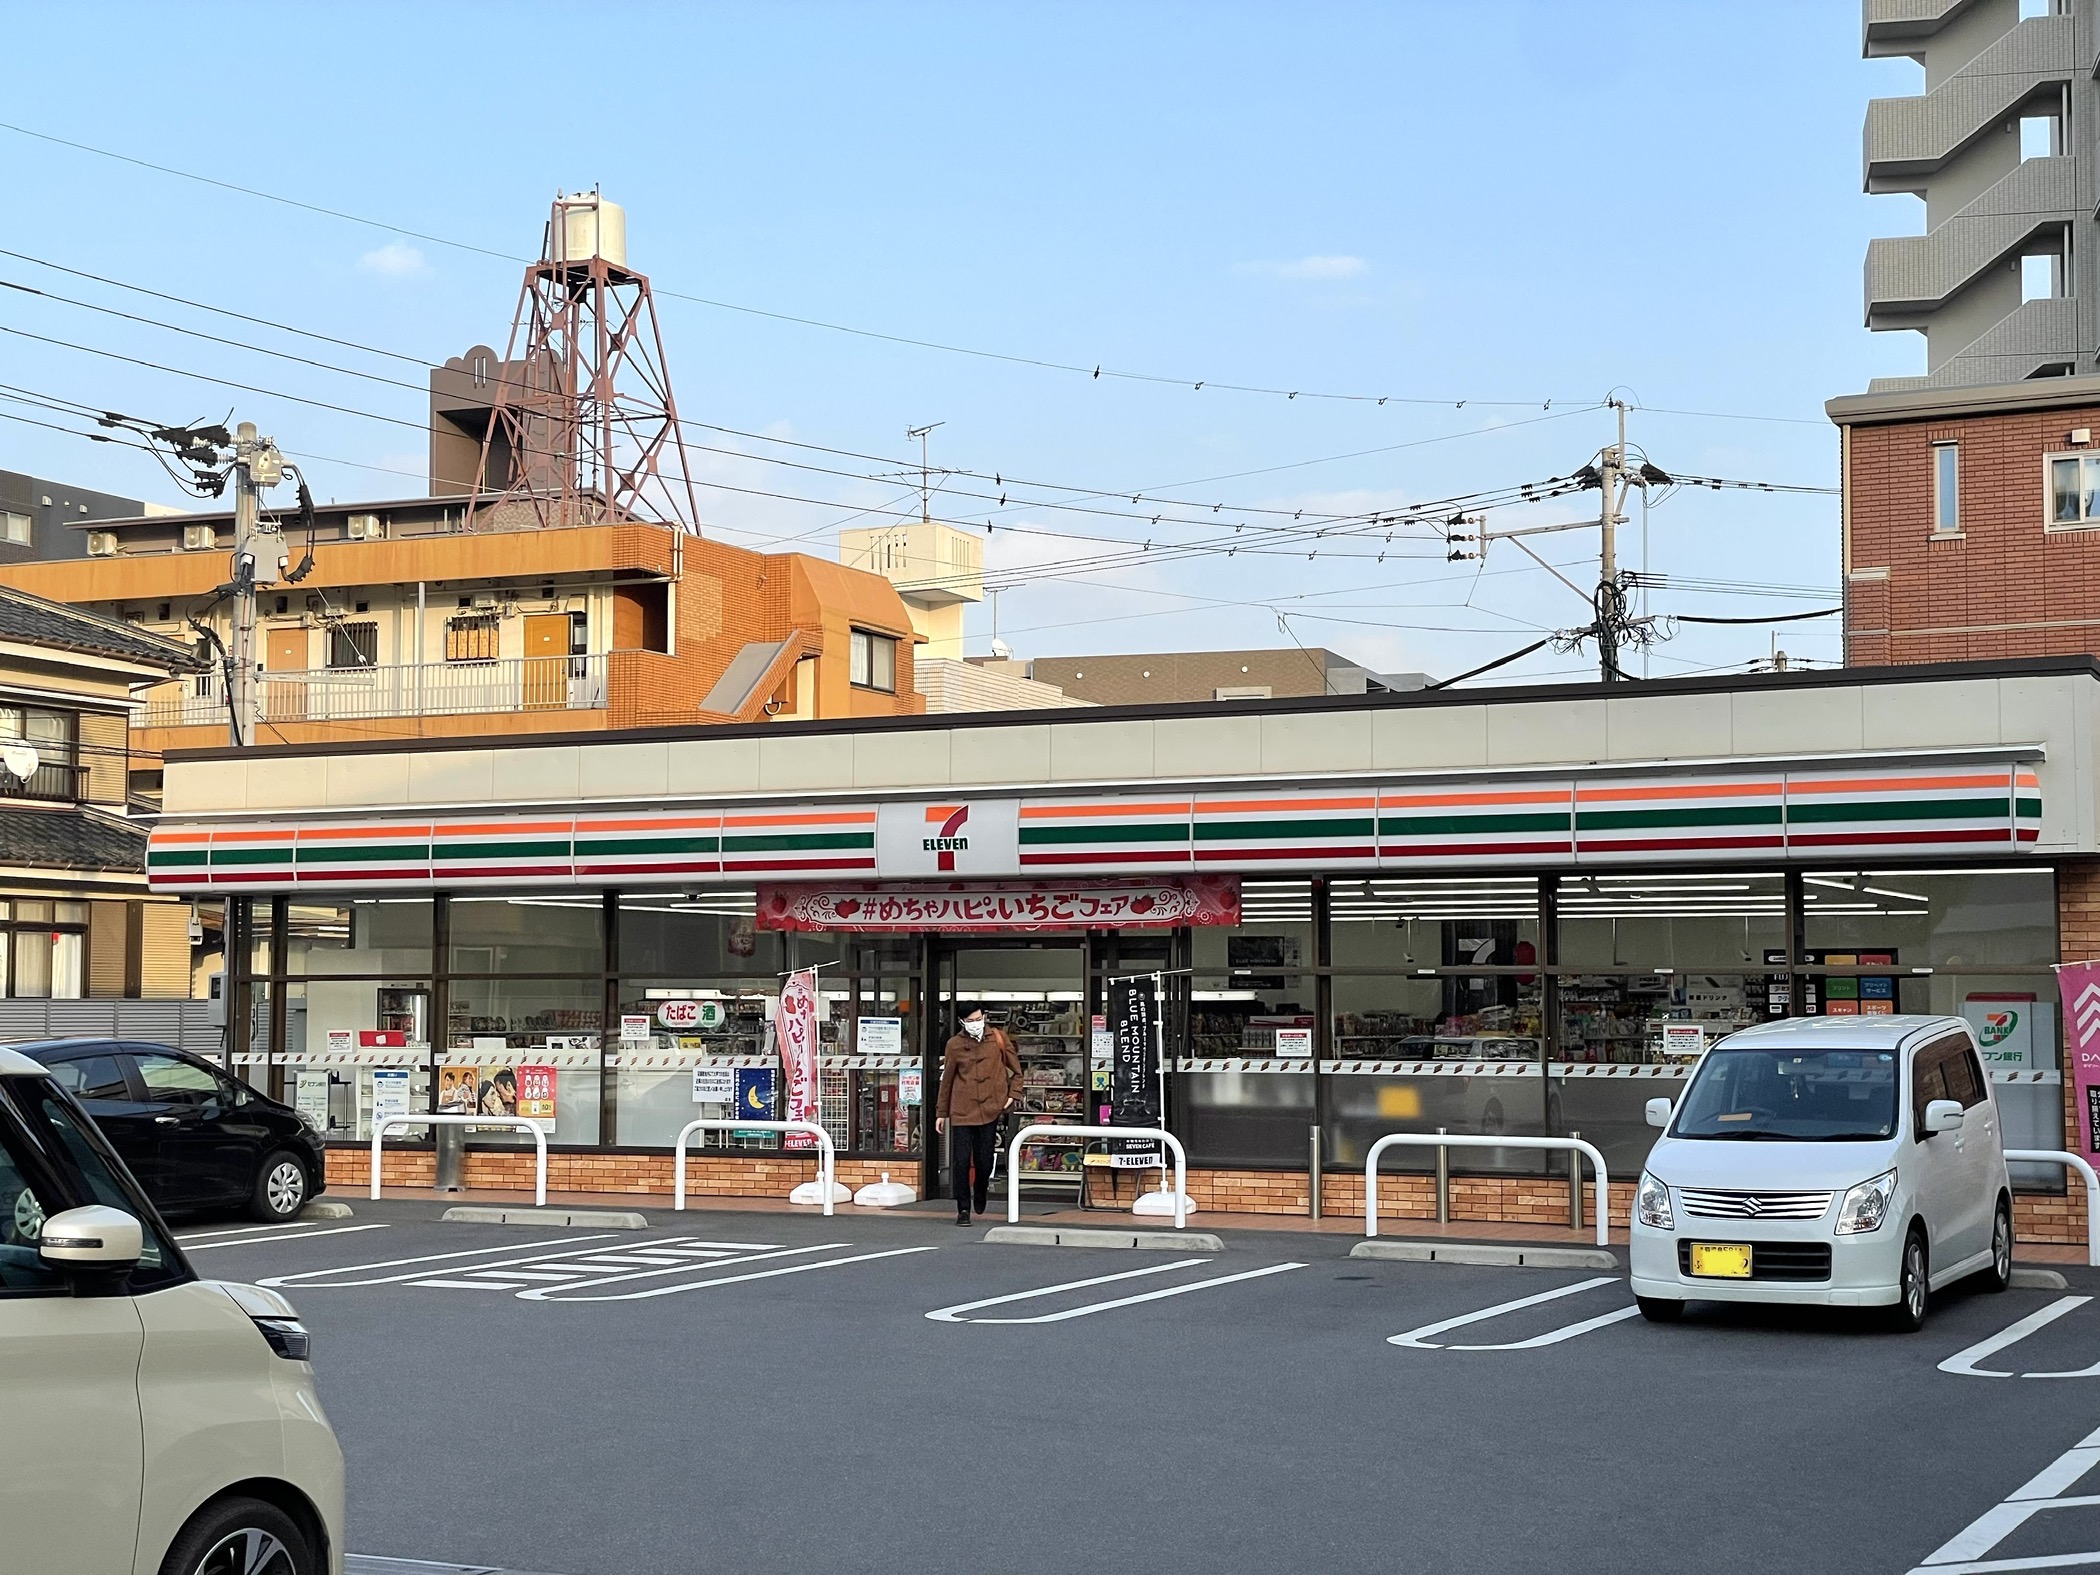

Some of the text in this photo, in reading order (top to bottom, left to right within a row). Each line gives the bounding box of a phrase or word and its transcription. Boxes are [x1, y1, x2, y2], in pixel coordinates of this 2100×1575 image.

[926, 805, 969, 871] 7
[666, 1004, 716, 1021] たばこ 酒
[1984, 1026, 2010, 1035] BANK
[1120, 1020, 1131, 1063] BLEND
[1129, 989, 1140, 1093] BLUE MOUNTAIN
